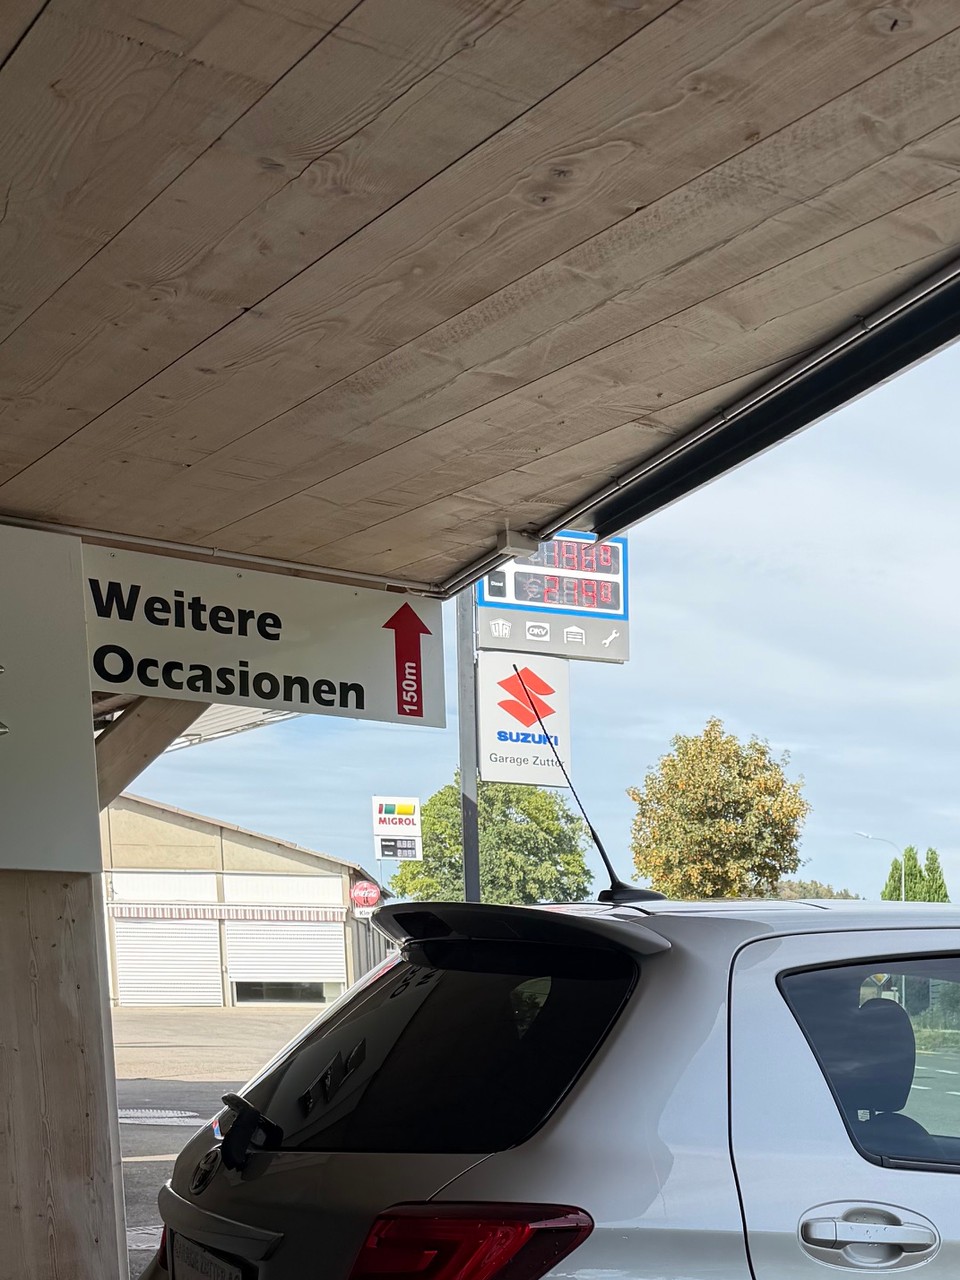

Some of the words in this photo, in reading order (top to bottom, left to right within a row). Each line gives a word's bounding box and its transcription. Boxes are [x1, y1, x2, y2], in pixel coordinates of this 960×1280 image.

[88, 577, 283, 642] Weitere
[92, 644, 366, 711] Occasionen
[402, 661, 418, 713] 150m
[489, 752, 529, 767] Garage
[378, 816, 417, 826] MIGROL
